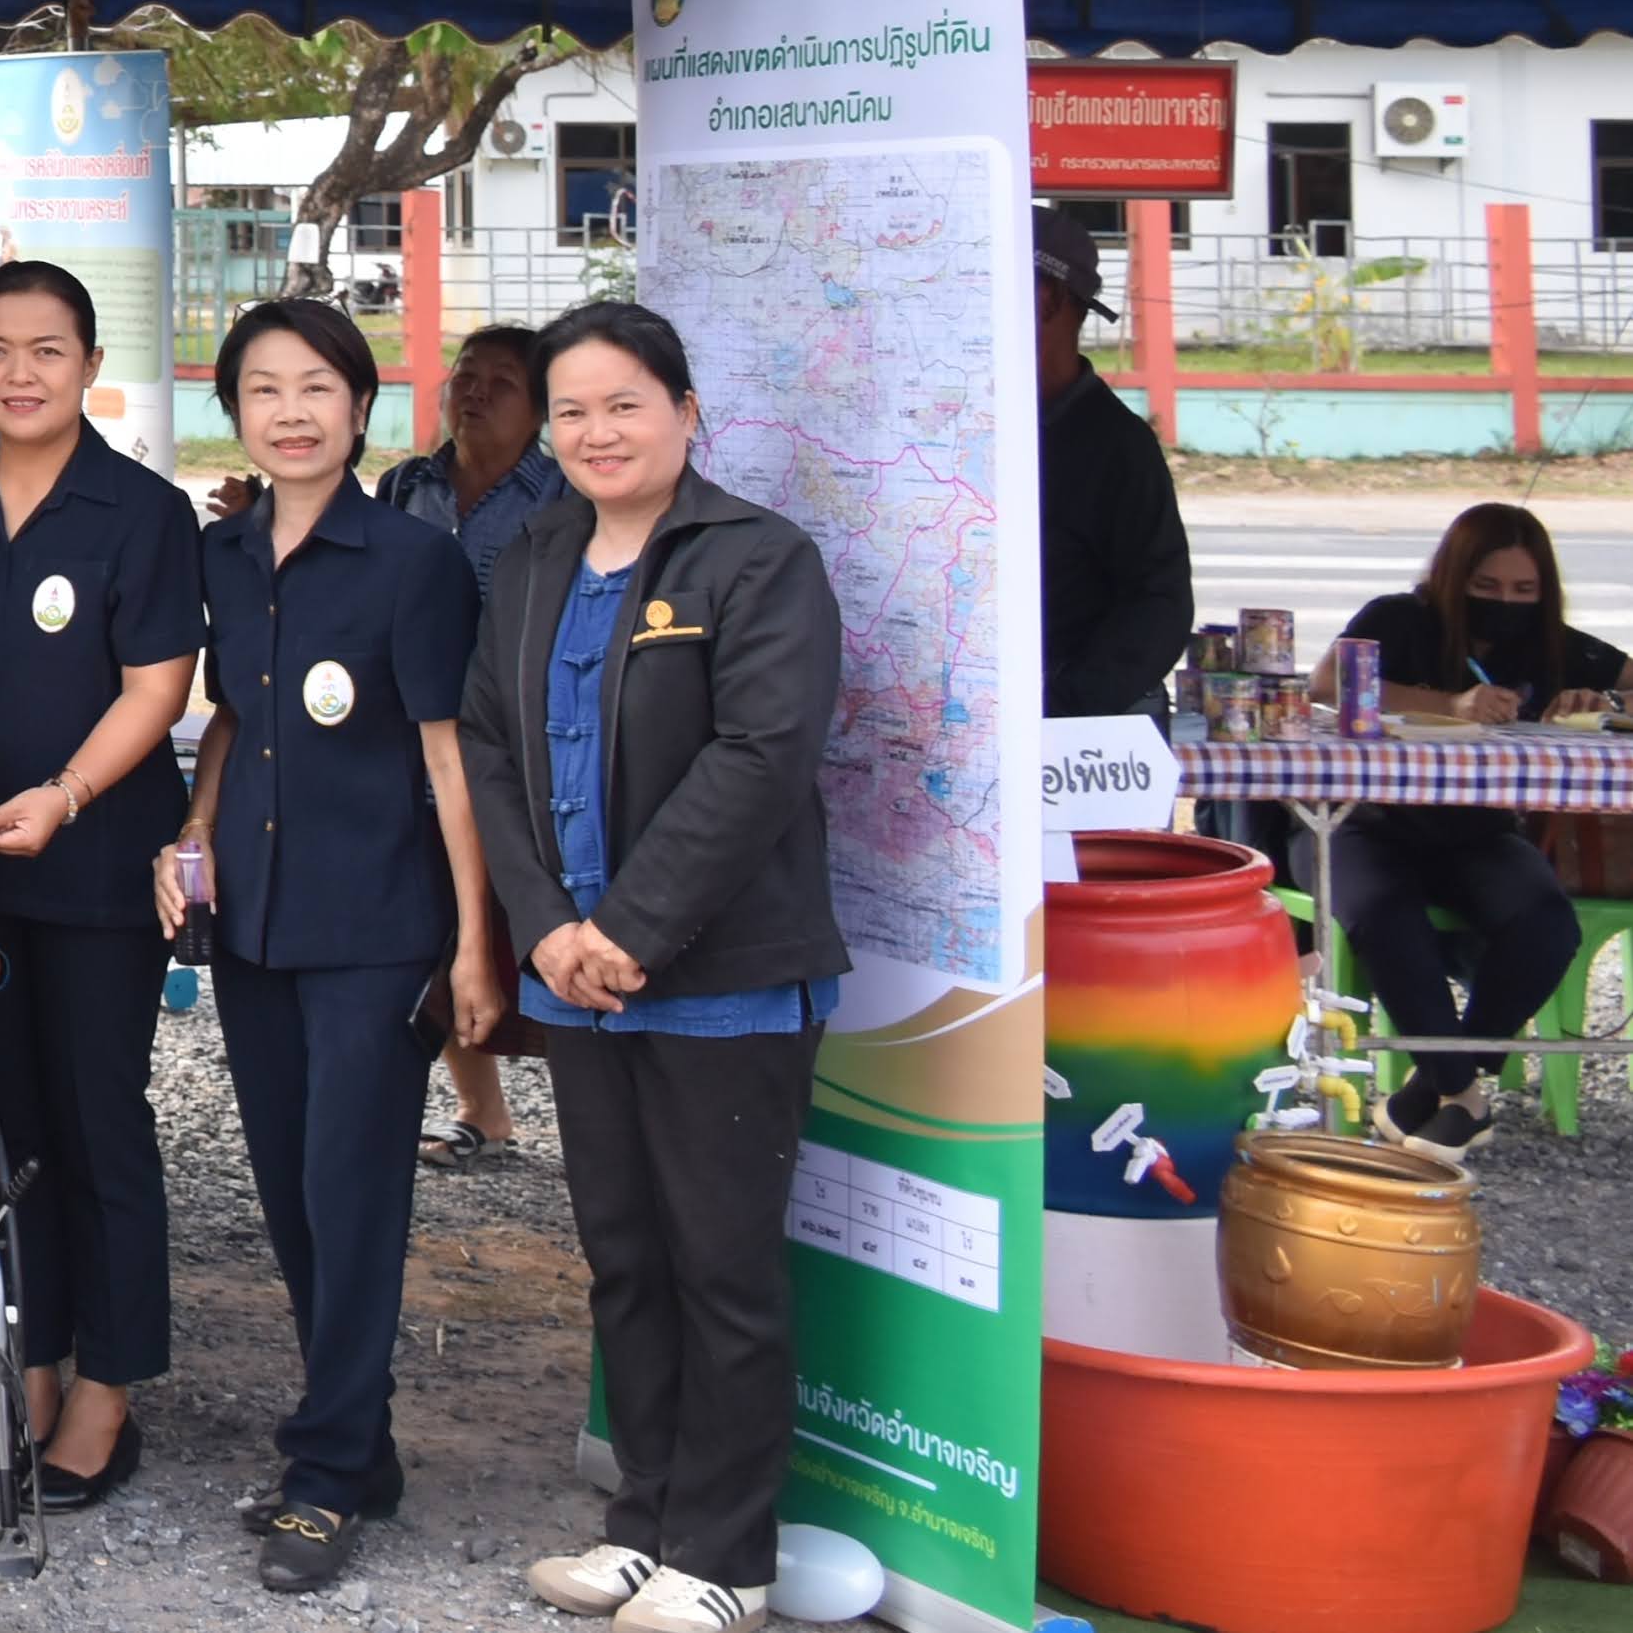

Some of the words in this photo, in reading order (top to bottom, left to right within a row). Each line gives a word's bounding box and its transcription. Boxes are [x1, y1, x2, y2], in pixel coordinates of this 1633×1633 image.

[644, 9, 990, 84] แผนที่แสดงเขตดำเนินการปฏิรูปที่ดิน
[709, 91, 892, 133] อำเภอเสนางคนิคม
